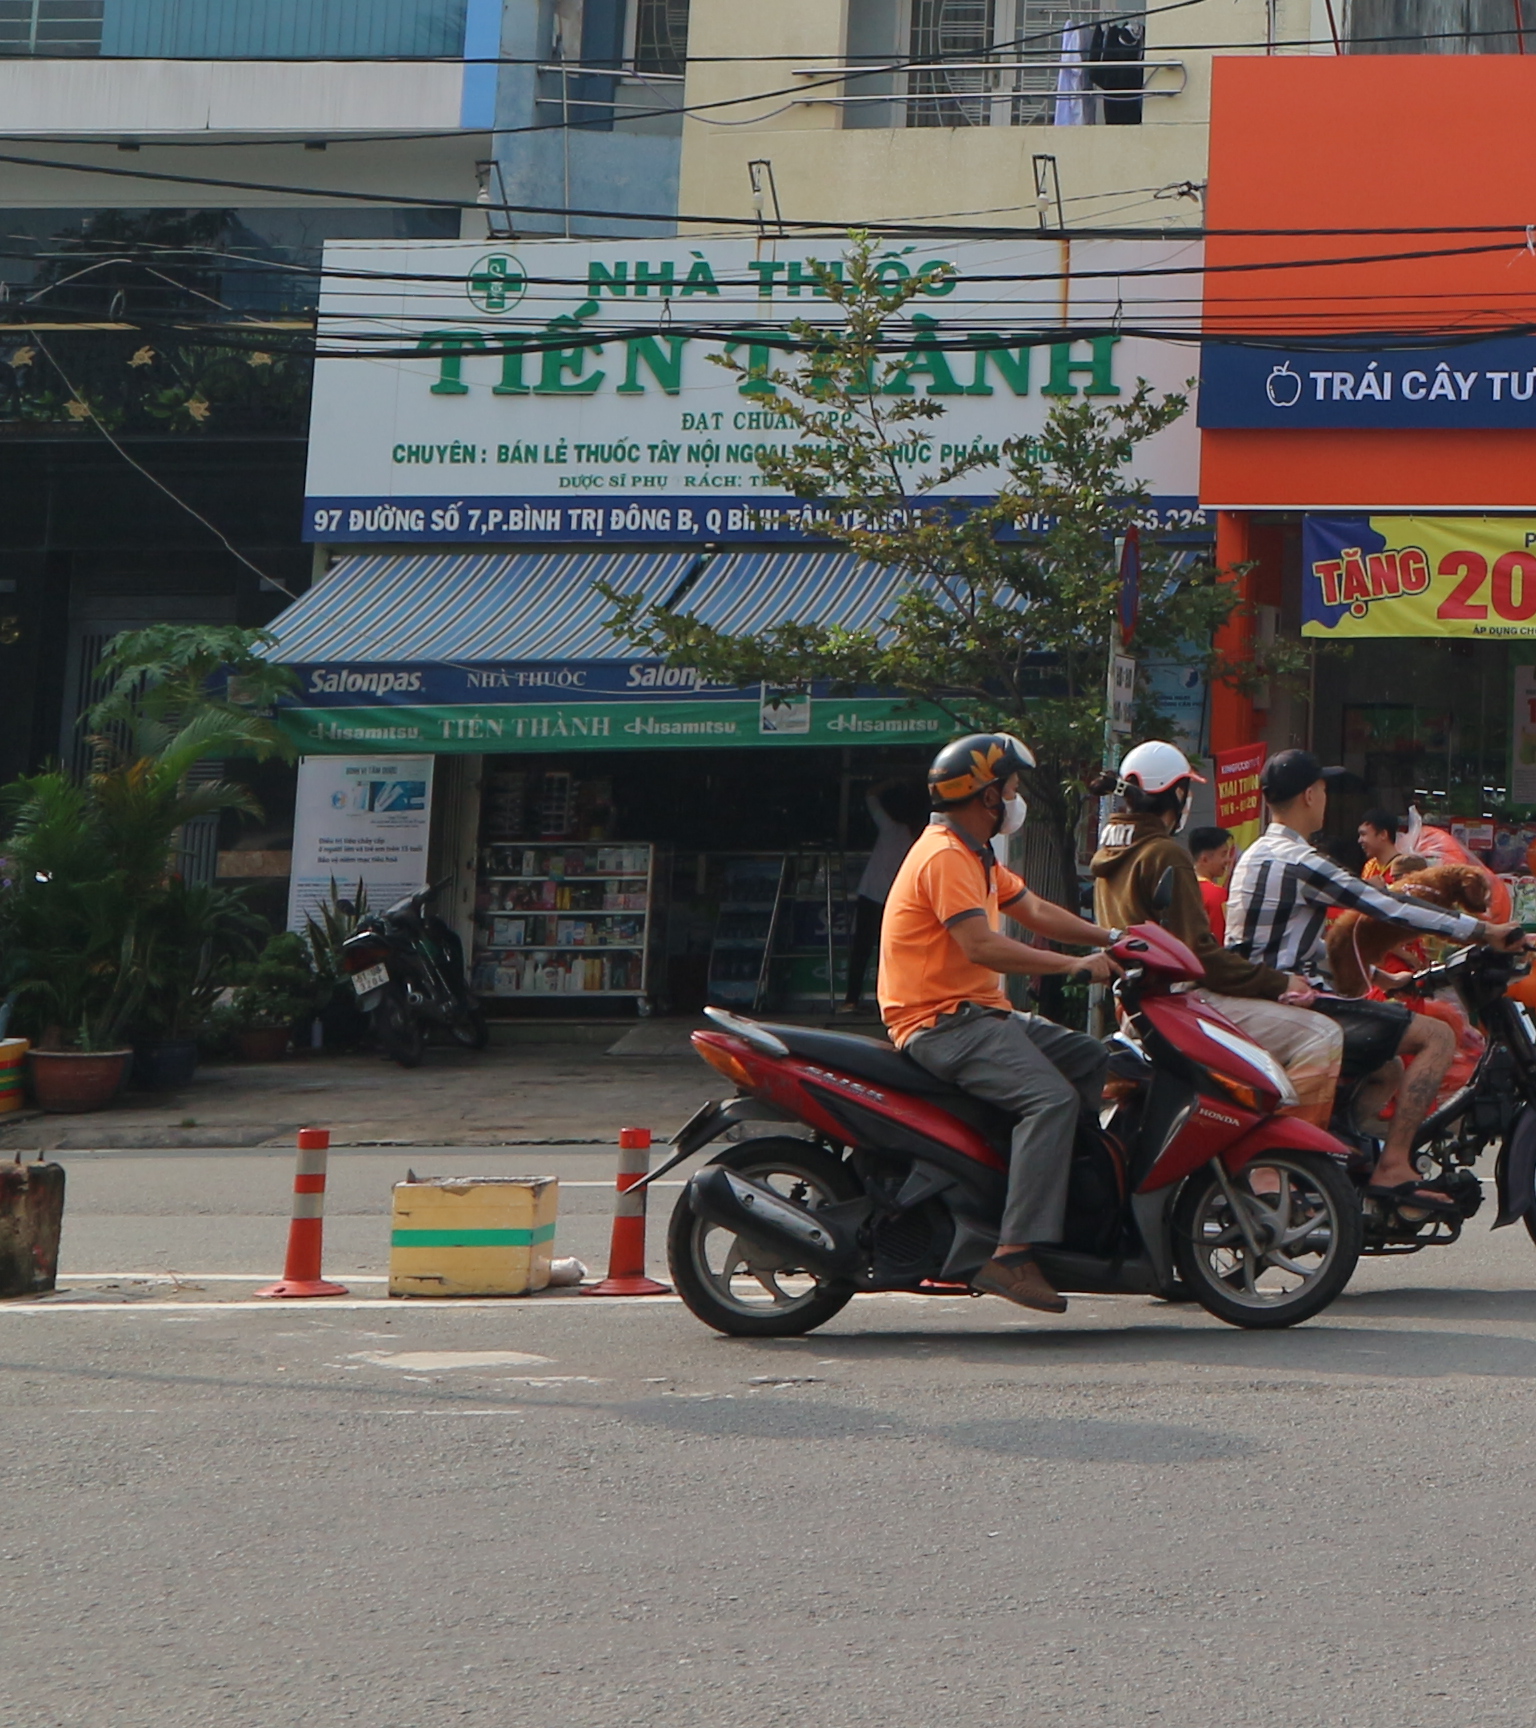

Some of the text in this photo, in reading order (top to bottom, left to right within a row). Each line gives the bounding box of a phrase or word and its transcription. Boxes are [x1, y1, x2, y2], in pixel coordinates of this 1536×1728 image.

[588, 251, 719, 296] NHÀ
[415, 300, 691, 395] TIẾN
[1309, 361, 1392, 401] TRÁI
[1402, 361, 1478, 401] CÂY
[681, 411, 724, 434] ĐẠT
[393, 437, 477, 463] CHUYÊN
[497, 437, 538, 463] BÁN
[544, 437, 567, 463] LẺ
[574, 436, 640, 463] THUỐC
[648, 438, 681, 463] TÂY
[688, 438, 720, 468] NỘI
[559, 475, 604, 490] DƯỢC
[609, 474, 626, 488] SĨ
[632, 475, 668, 489] PHỤ
[314, 510, 342, 531] 97
[349, 506, 424, 531] ĐƯỜNG
[431, 502, 463, 531] SỐ
[568, 508, 603, 535] TRỊ
[610, 504, 670, 531] ĐÔNG
[678, 510, 698, 534] B,
[706, 510, 721, 532] Q
[1312, 545, 1430, 618] TẶNG
[1472, 625, 1487, 635] ÁP
[1489, 626, 1518, 637] DỤNG
[309, 667, 587, 697] Salonpas NHÀ THUỐC
[308, 710, 939, 741] Hisamitsu TIẾN THÀNH Hisamitsu Hisamitsu
[1198, 1106, 1240, 1128] HONDA
